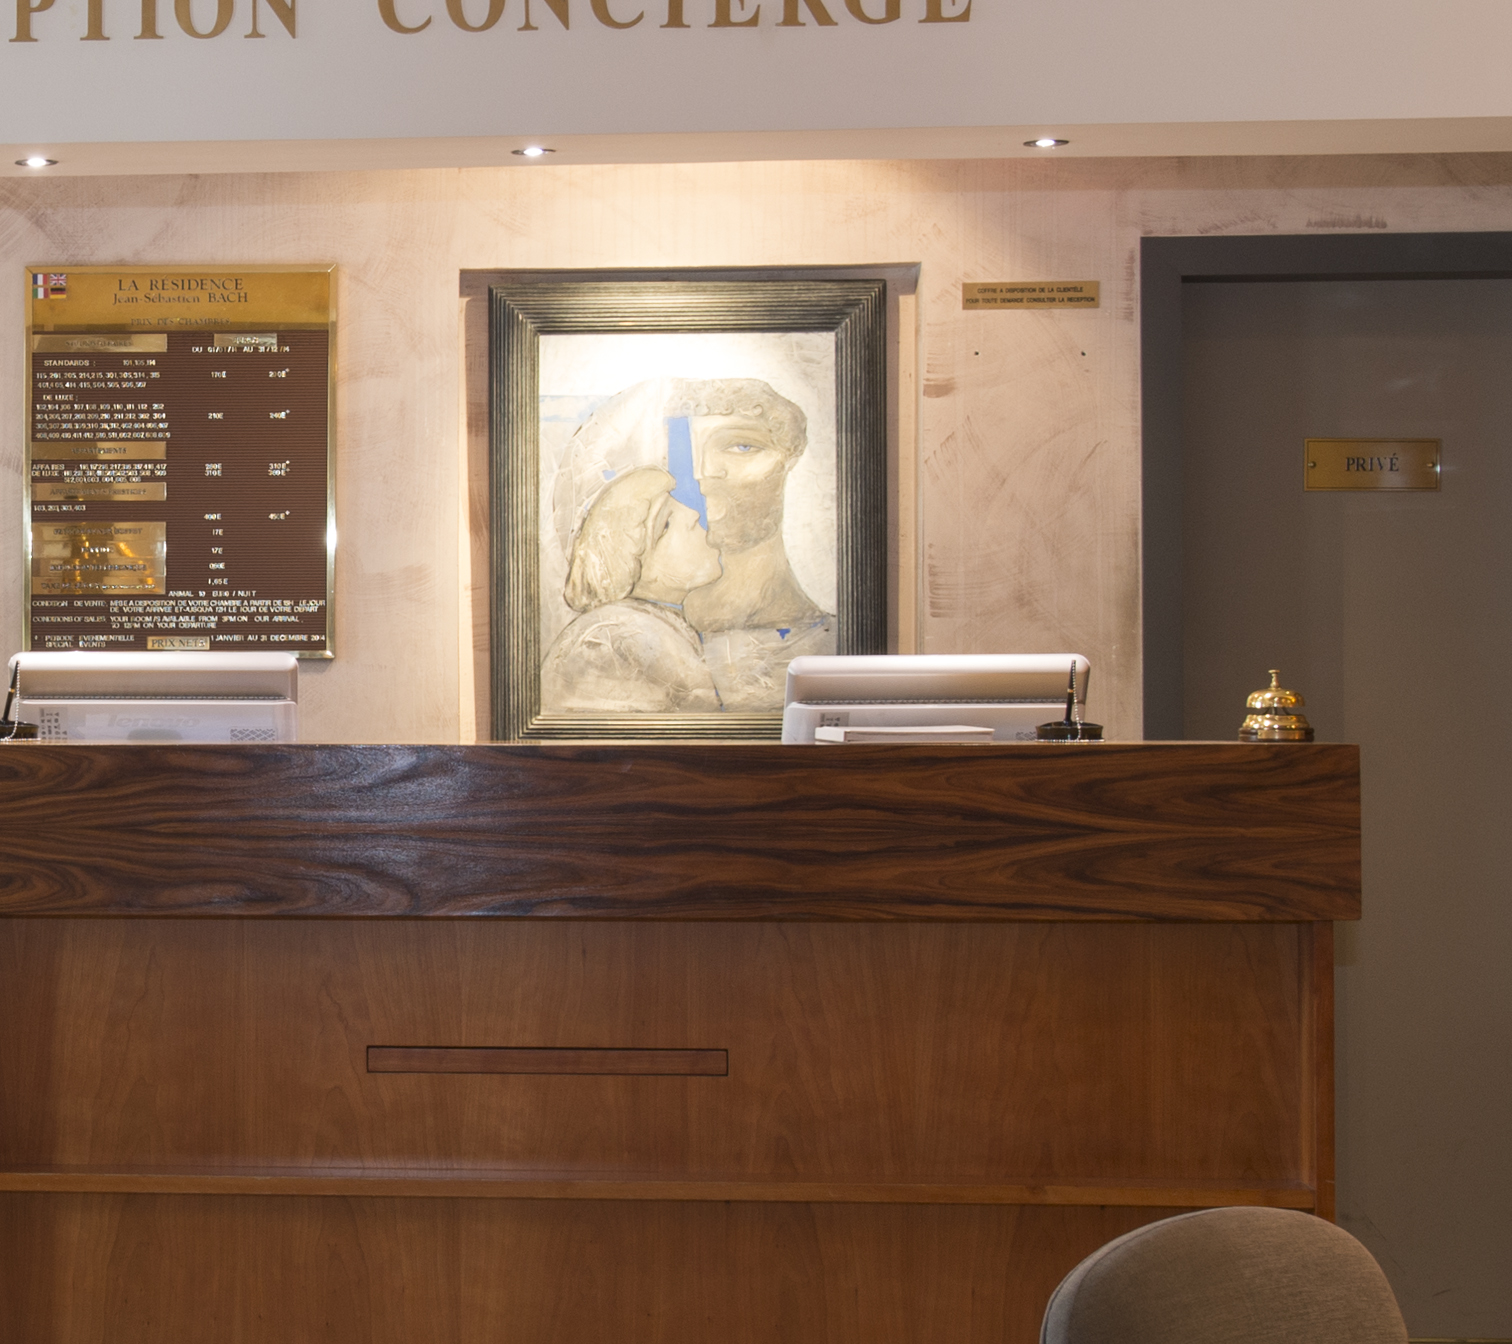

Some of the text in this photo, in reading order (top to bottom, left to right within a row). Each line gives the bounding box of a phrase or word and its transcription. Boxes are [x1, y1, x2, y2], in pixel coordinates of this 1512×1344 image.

[118, 275, 243, 291] LA RÉSIDENCE
[113, 292, 248, 305] Jean-Sébastien BACH
[131, 318, 231, 326] PRIX DES CHAMBRES
[1345, 452, 1399, 472] PRIVÉ
[151, 638, 177, 648] PRIX
[215, 634, 245, 642] JANVIER
[247, 634, 258, 642] AU
[269, 634, 308, 642] DECEMBRE
